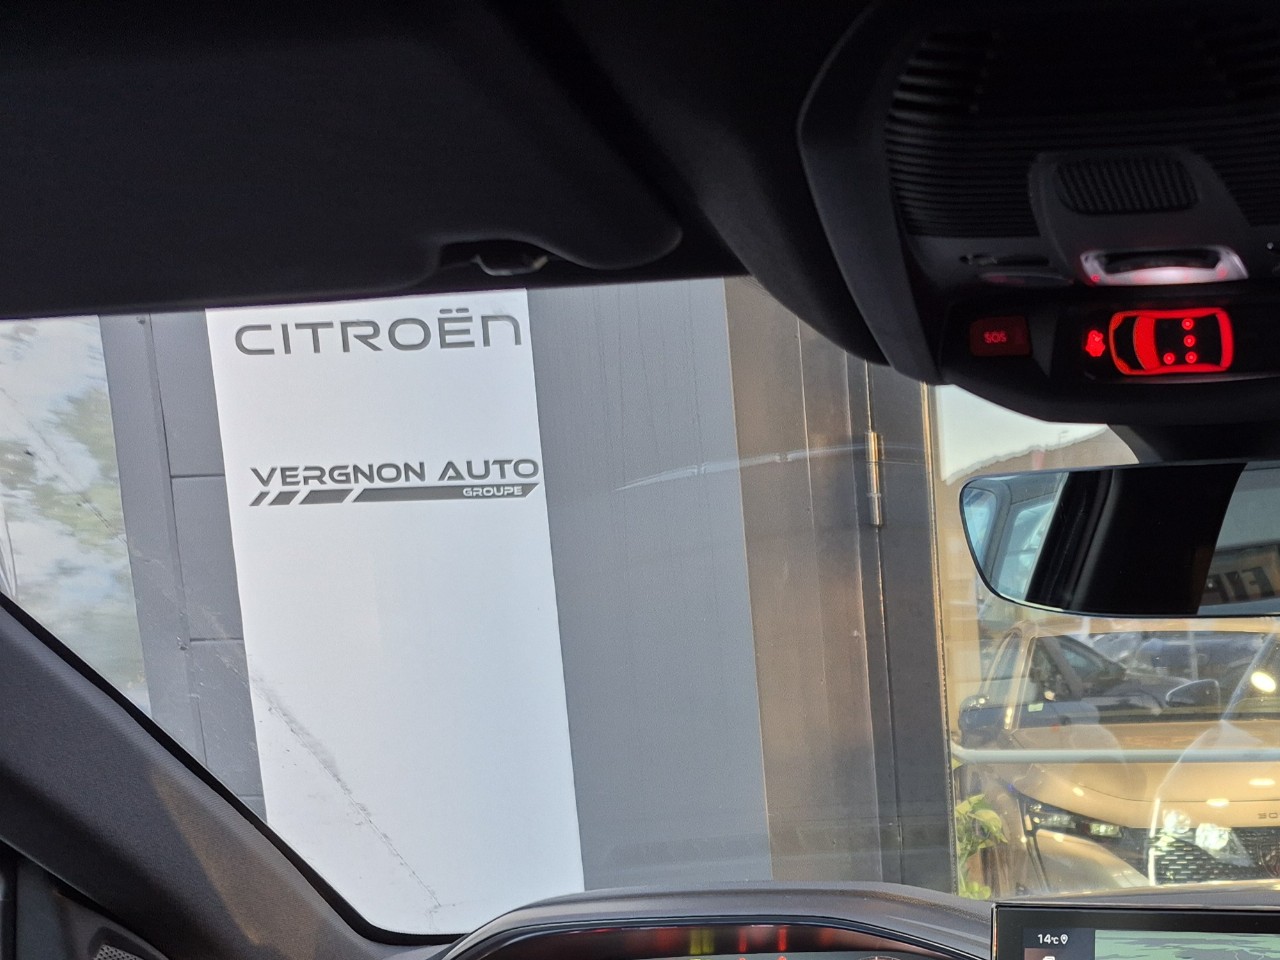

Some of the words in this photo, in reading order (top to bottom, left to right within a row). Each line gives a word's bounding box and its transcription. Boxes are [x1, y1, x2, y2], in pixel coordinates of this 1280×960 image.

[234, 307, 522, 356] CITROËN
[250, 461, 426, 487] VERGNON
[437, 458, 540, 482] AUTO
[462, 485, 523, 497] GROUPE
